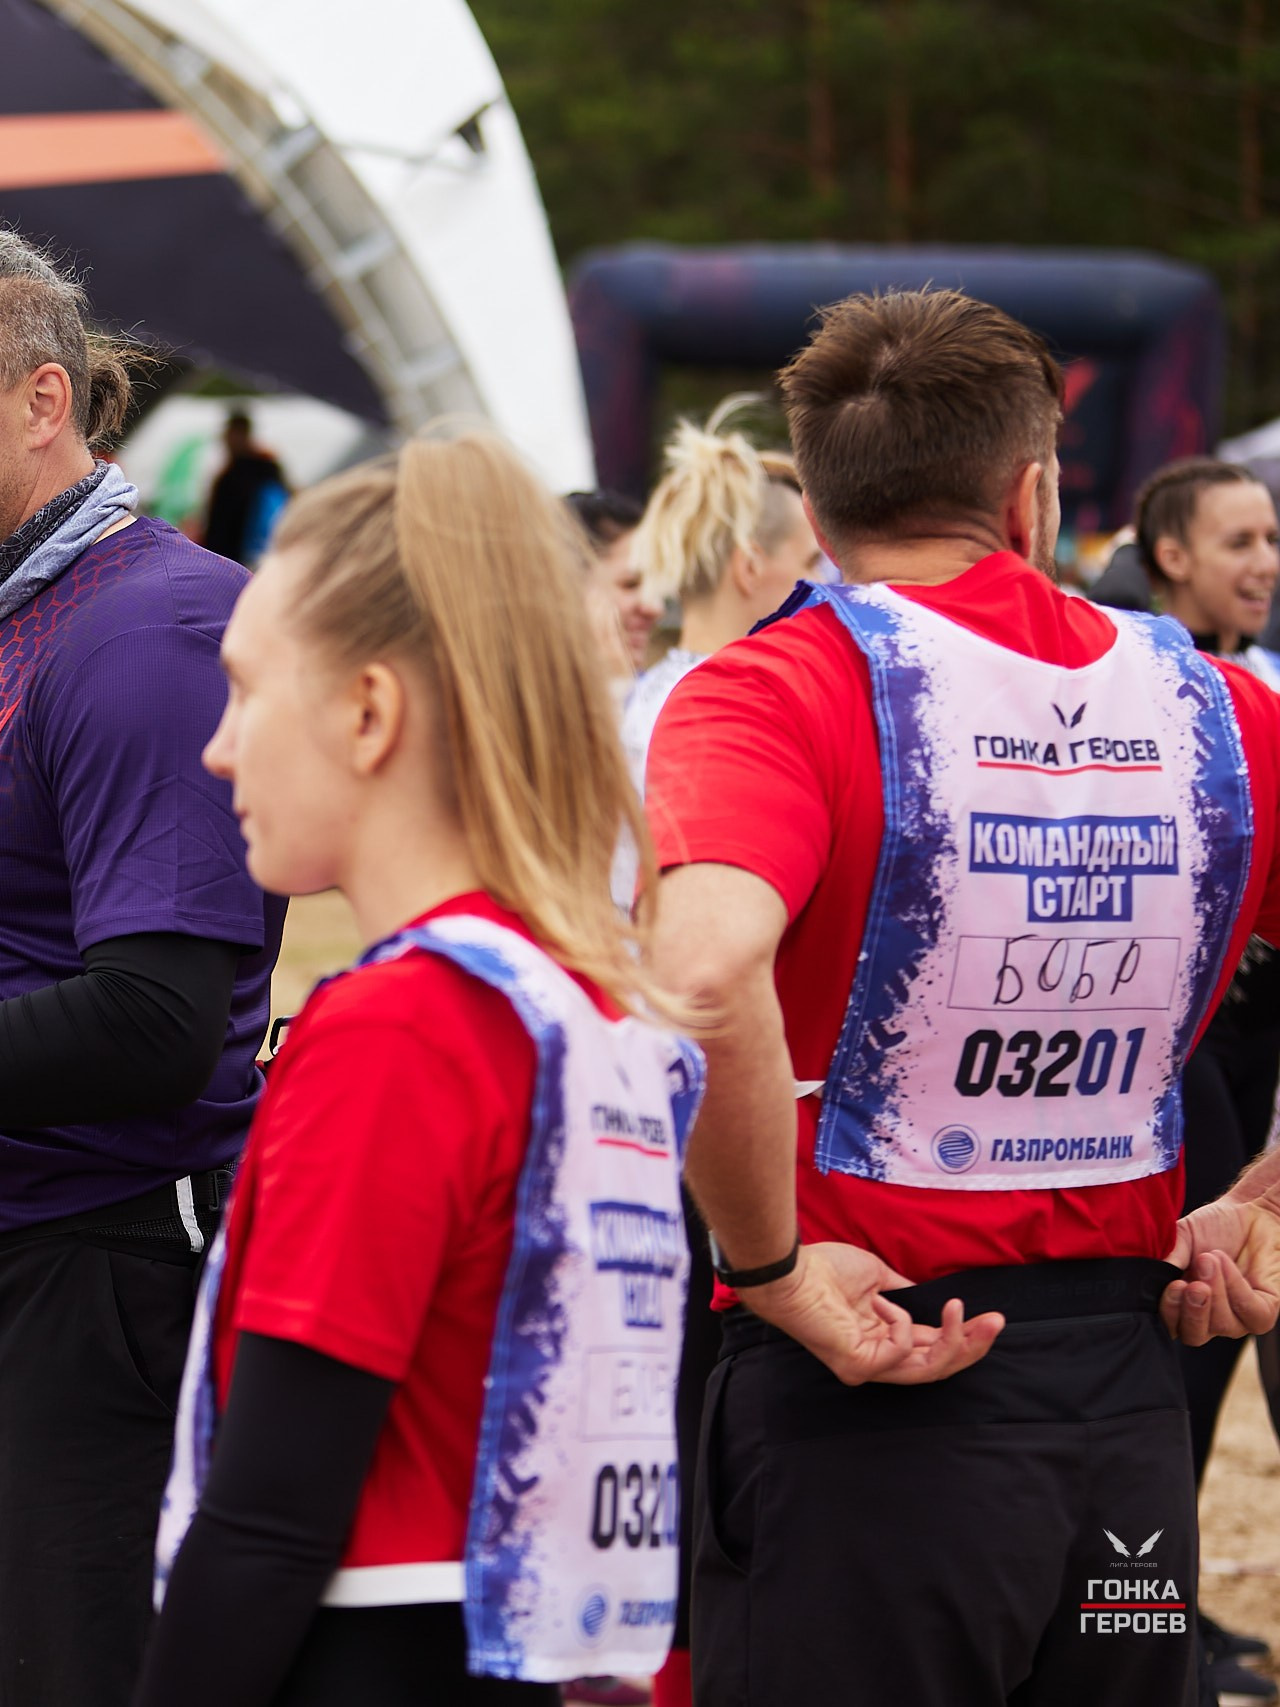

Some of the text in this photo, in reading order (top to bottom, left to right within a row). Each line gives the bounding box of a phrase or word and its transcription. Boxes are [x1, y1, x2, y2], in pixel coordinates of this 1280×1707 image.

[974, 736, 1160, 766] ГОНКА ГЕРОЕВ
[973, 814, 1175, 873] КОМАНДНЫЙ
[1032, 875, 1126, 917] СТАРТ
[994, 934, 1141, 1005] БОБР
[954, 1028, 1146, 1097] 03201
[990, 1135, 1133, 1162] ГАЗПРОМБАНК
